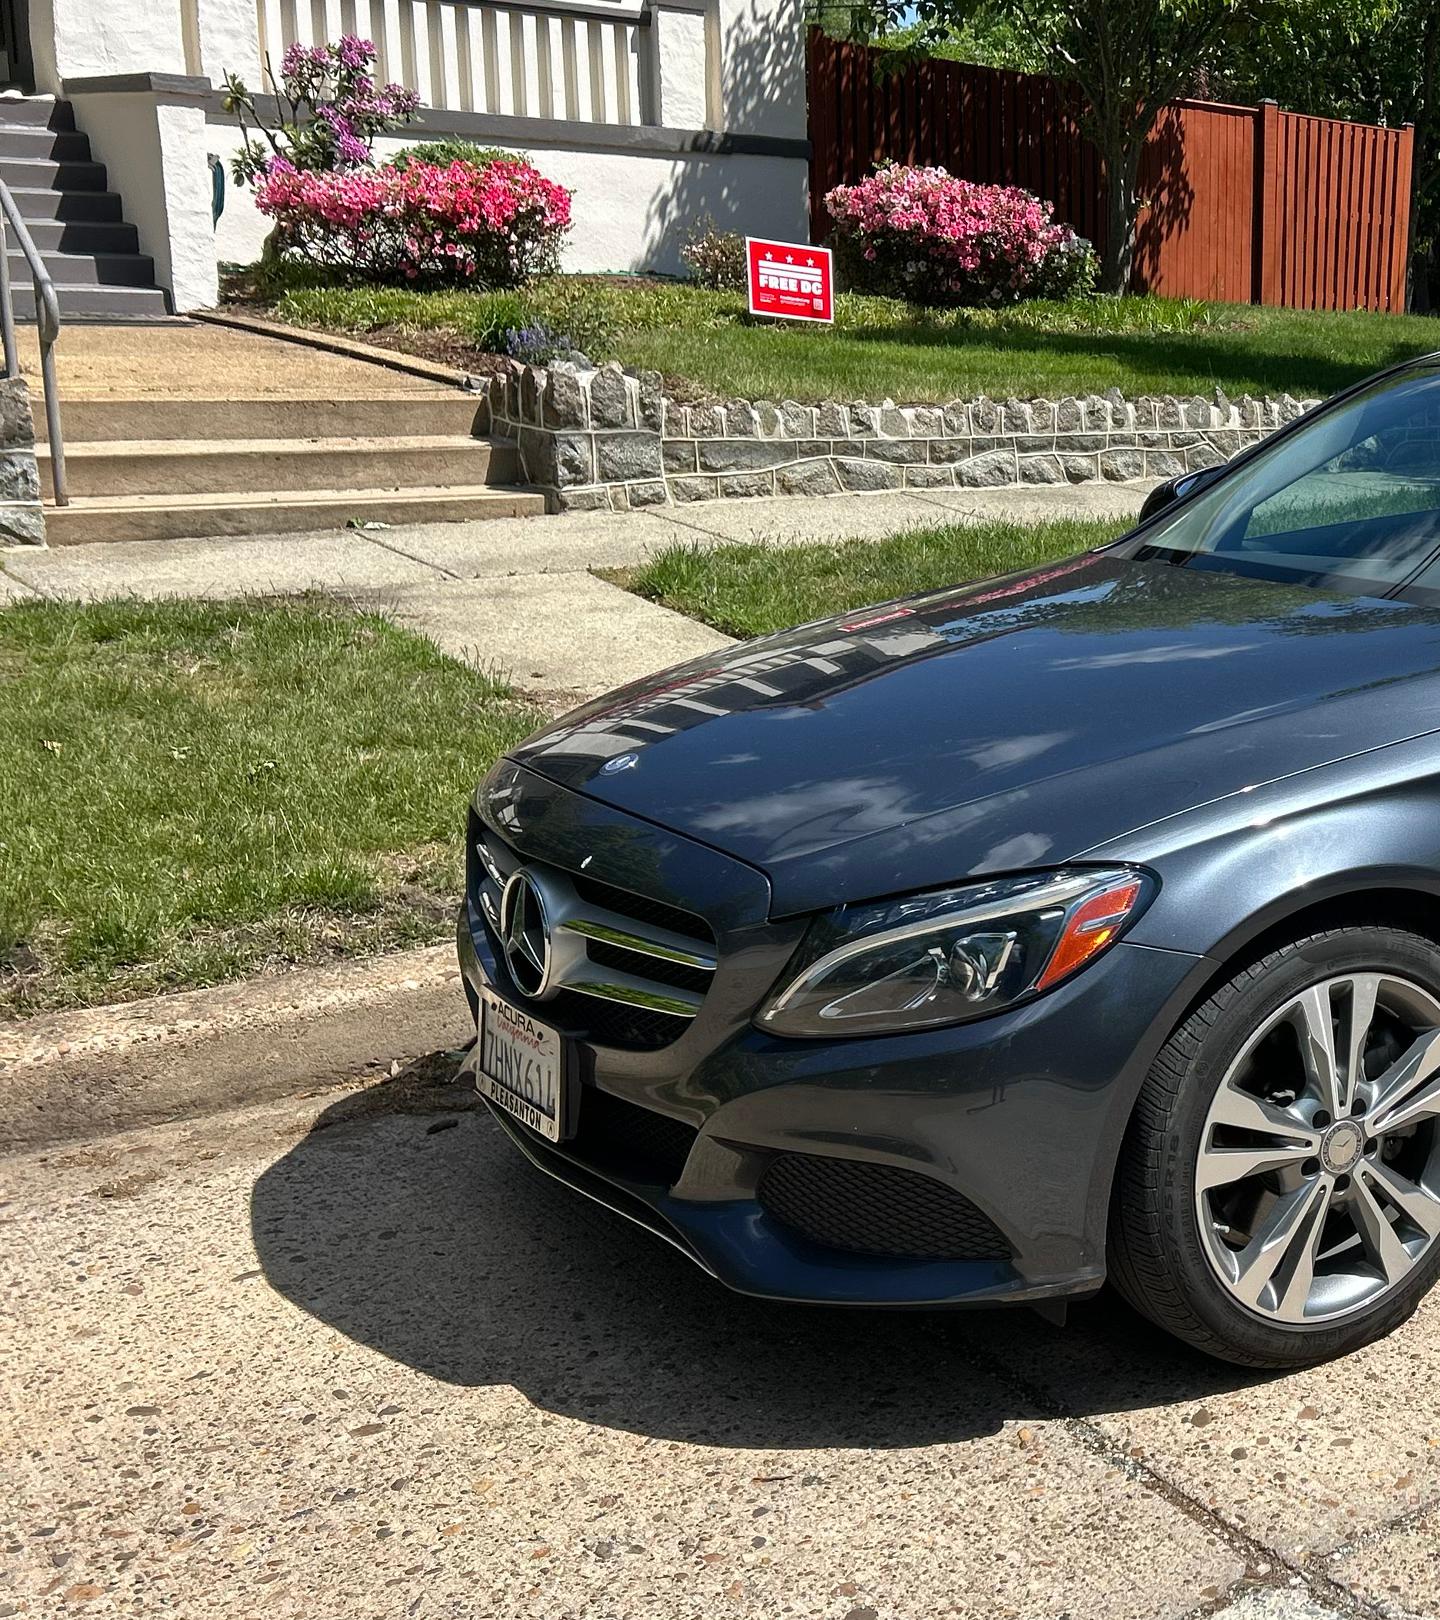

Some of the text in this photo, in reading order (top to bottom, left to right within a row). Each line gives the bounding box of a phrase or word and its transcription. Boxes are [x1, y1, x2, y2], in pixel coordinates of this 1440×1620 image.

[759, 275, 823, 295] FREE DC
[498, 1001, 535, 1037] ACURA
[487, 1029, 555, 1117] 7HNX614
[490, 1081, 541, 1131] PLEASANTON
